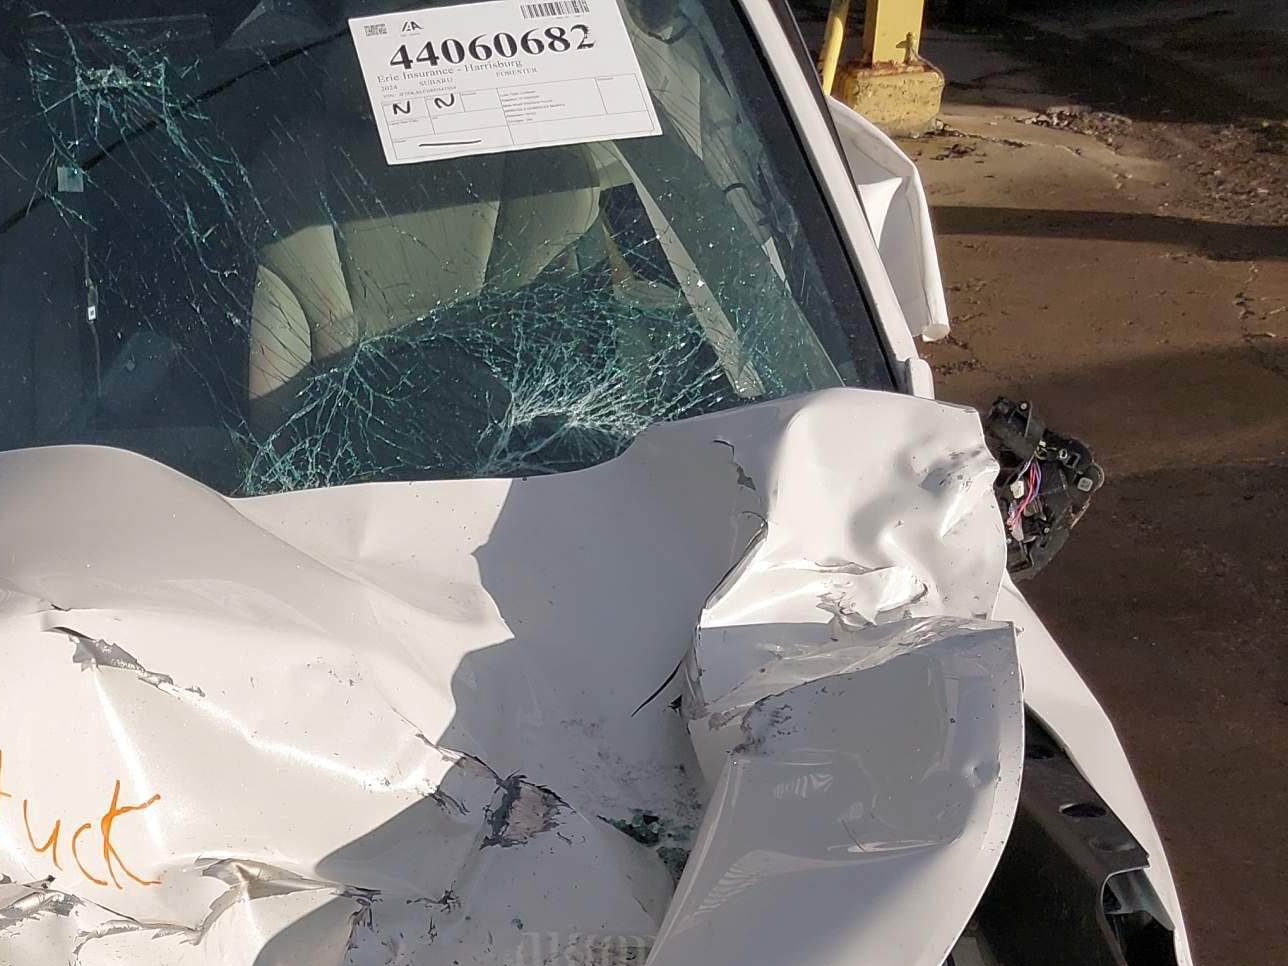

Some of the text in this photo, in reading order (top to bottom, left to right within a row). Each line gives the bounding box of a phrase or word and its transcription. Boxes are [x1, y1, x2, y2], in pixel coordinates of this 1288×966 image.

[390, 24, 595, 70] 44060682
[377, 73, 400, 84] Erie
[402, 67, 454, 80] Insurance
[464, 59, 523, 73] Harrisburg
[419, 77, 454, 87] SUBARU
